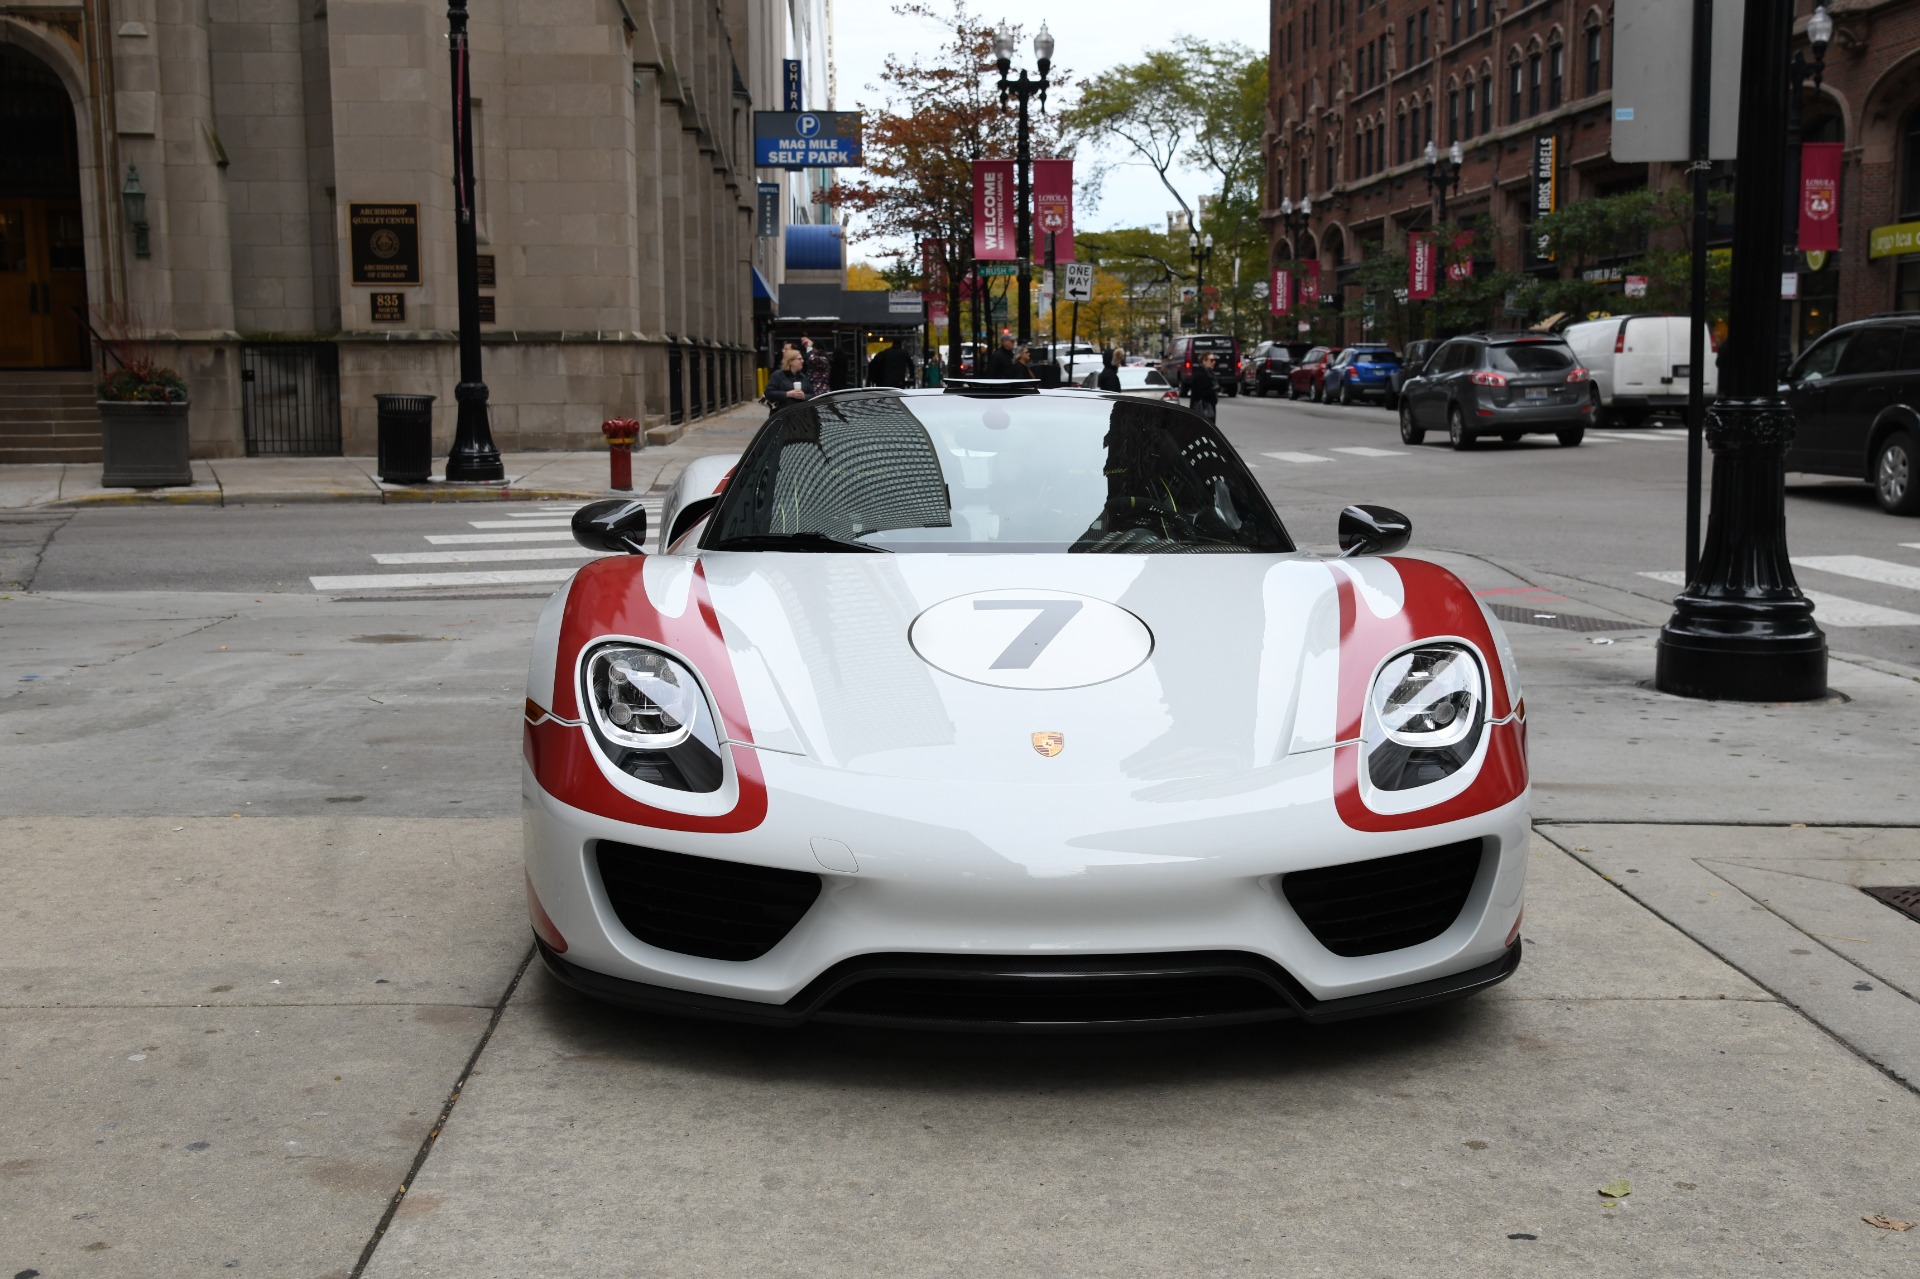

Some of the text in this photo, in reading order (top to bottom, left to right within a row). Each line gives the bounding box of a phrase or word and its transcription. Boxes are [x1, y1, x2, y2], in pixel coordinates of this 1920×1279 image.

[802, 117, 815, 134] P
[779, 139, 838, 149] MAG MILE
[768, 151, 848, 163] SELF PARK
[1539, 136, 1553, 178] BAGELS
[360, 208, 407, 216] ARCHBISHOP
[984, 172, 997, 250] WELCOME
[352, 217, 415, 225] QUIGLEY CENTER
[986, 267, 1007, 276] RUSH
[1068, 266, 1090, 276] ONE
[1067, 277, 1090, 287] WAY
[377, 295, 399, 306] 835
[972, 600, 1083, 670] 7
